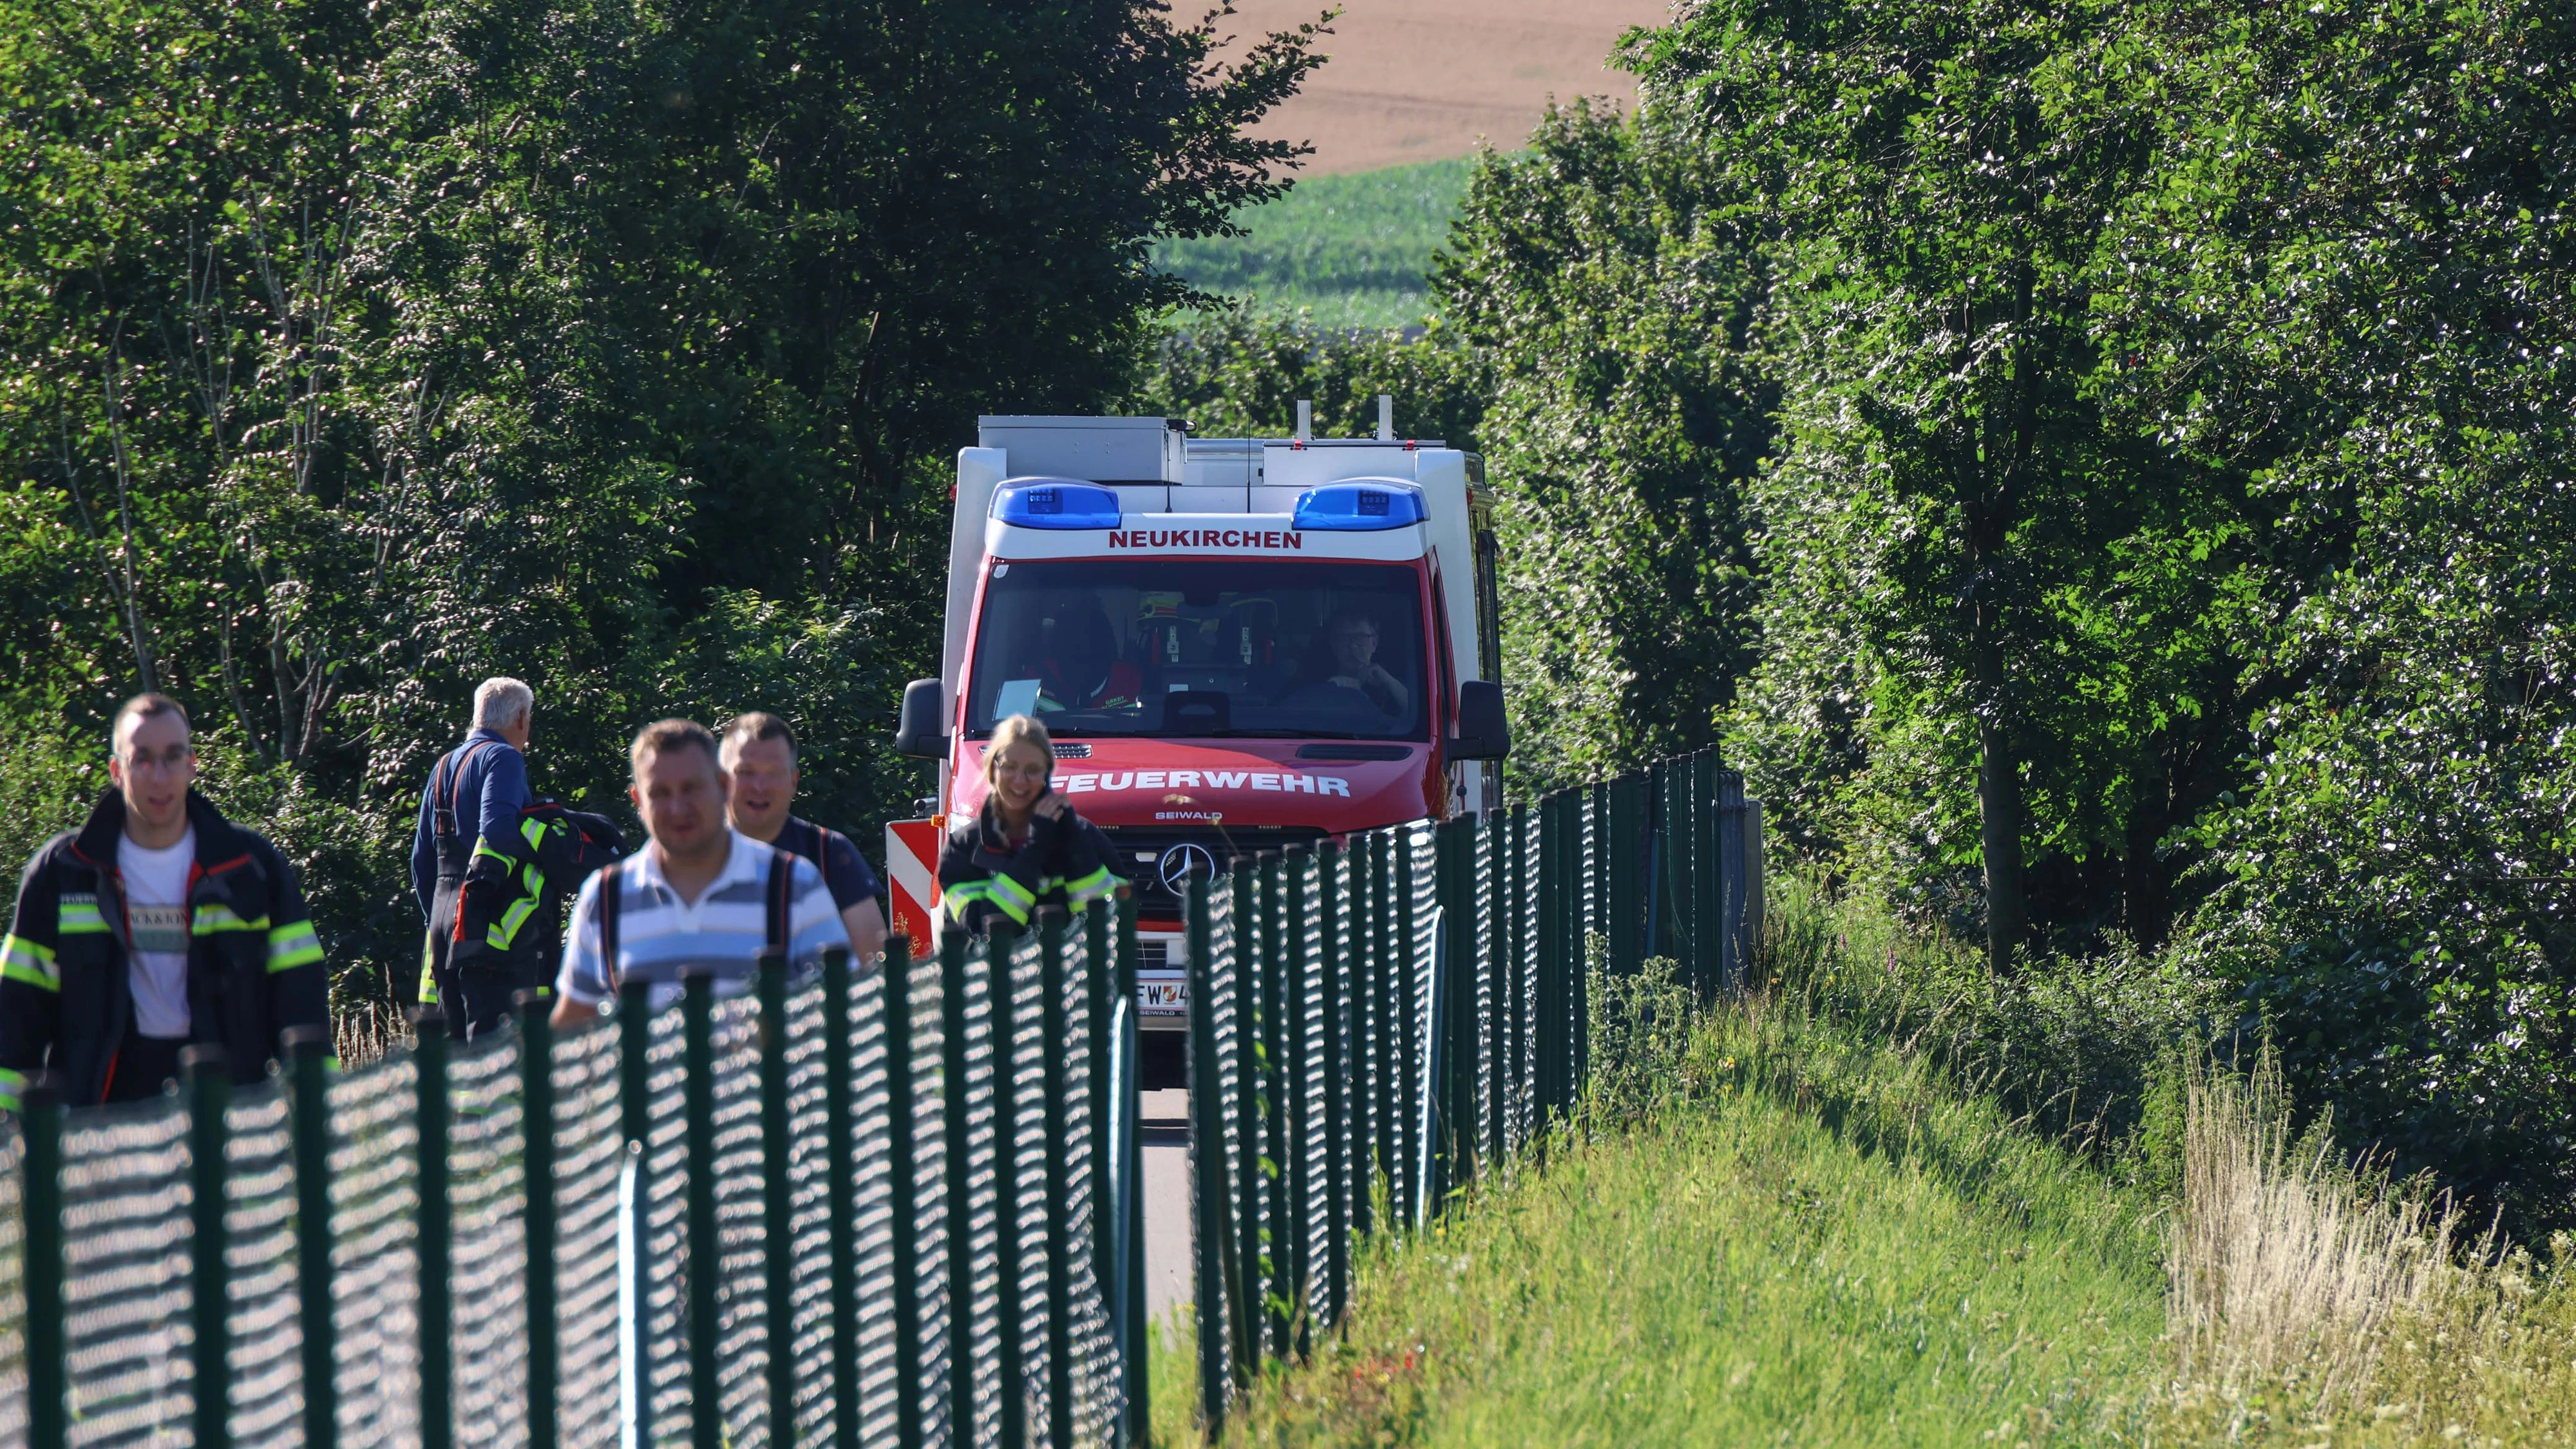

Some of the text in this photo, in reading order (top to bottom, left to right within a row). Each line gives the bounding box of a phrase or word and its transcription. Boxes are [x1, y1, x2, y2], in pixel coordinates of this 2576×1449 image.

[1109, 530, 1302, 549] NEUKIRCHEN
[1050, 770, 1350, 797] FEUERWEHR
[1155, 811, 1223, 820] SEIWALD
